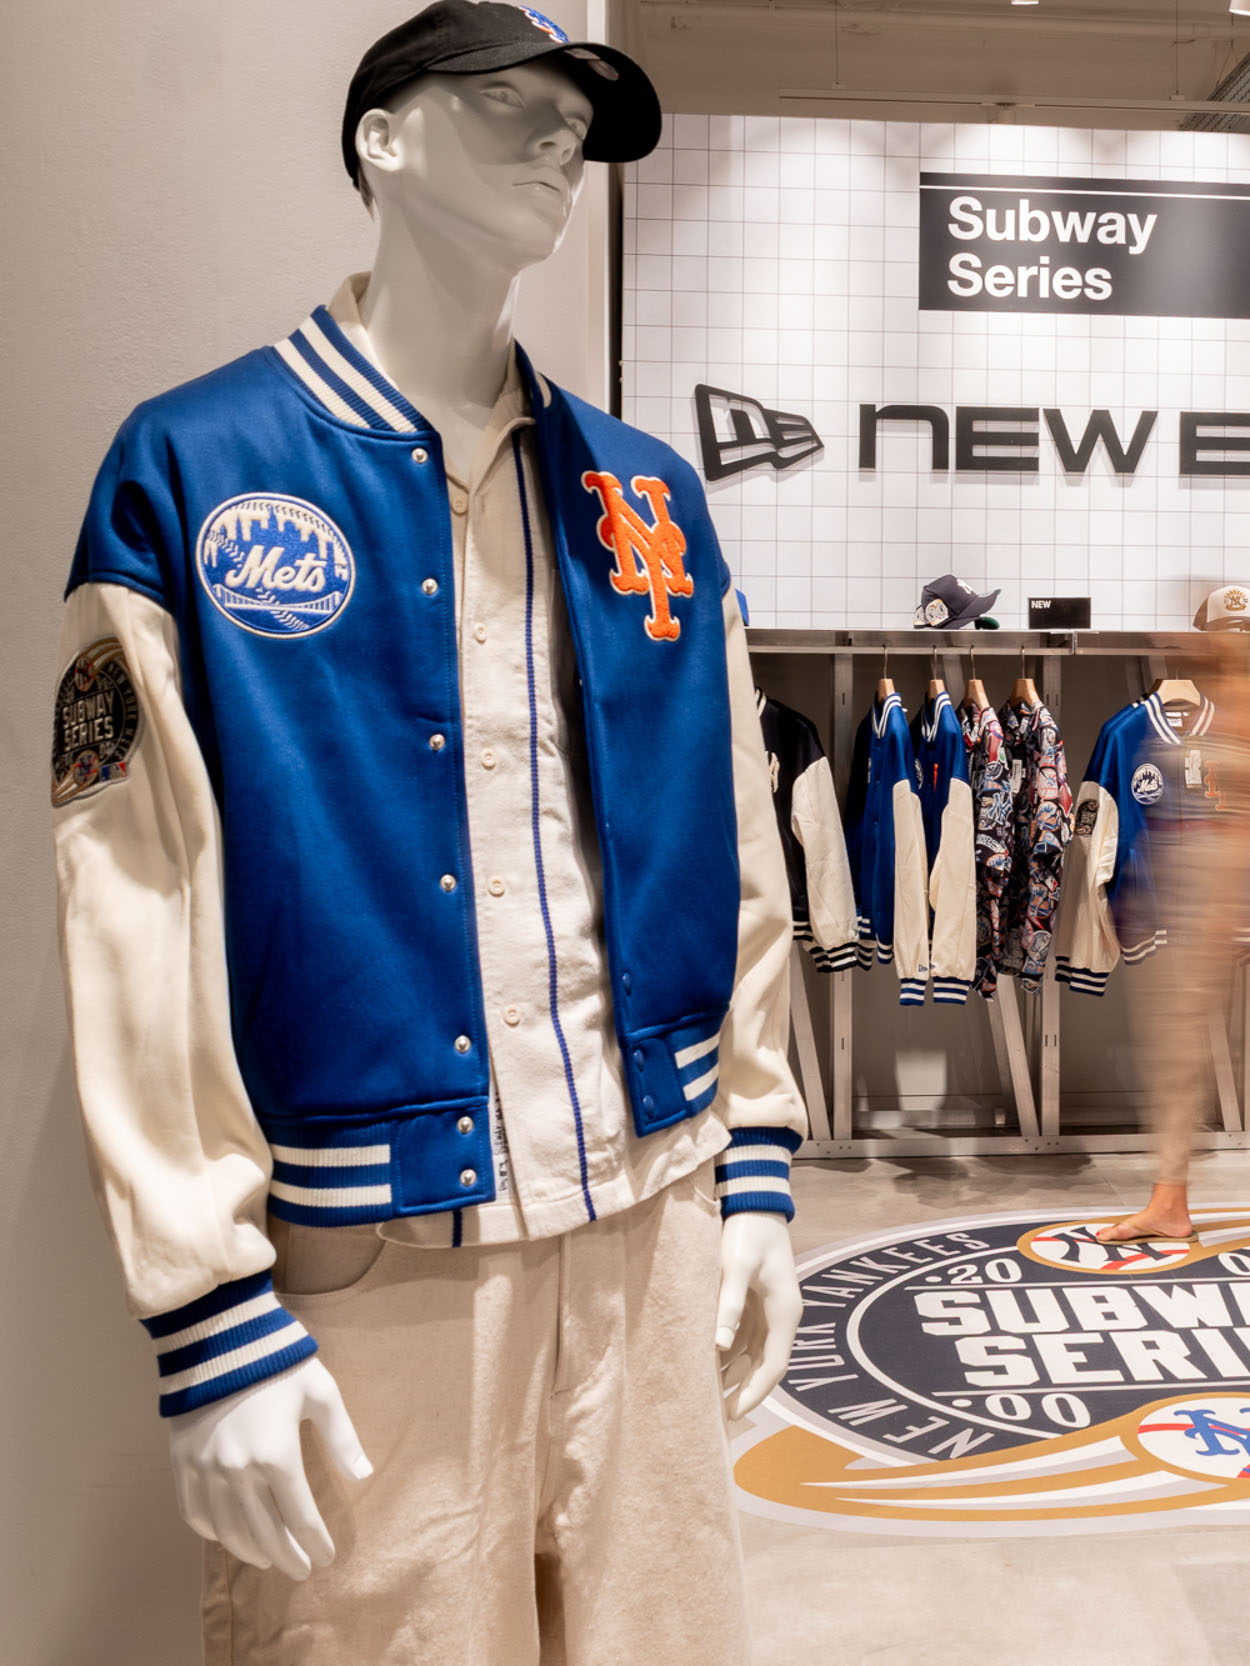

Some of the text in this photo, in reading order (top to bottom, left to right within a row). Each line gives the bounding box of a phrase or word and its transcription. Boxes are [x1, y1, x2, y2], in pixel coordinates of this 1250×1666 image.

[947, 195, 1158, 255] Subway
[947, 252, 1113, 301] Series
[224, 544, 328, 593] Mets
[1030, 600, 1052, 609] NEW
[62, 690, 115, 730] SUBWAY
[64, 716, 115, 752] SERIES
[801, 1232, 990, 1308] YANKEES
[827, 1398, 996, 1460] NEW
